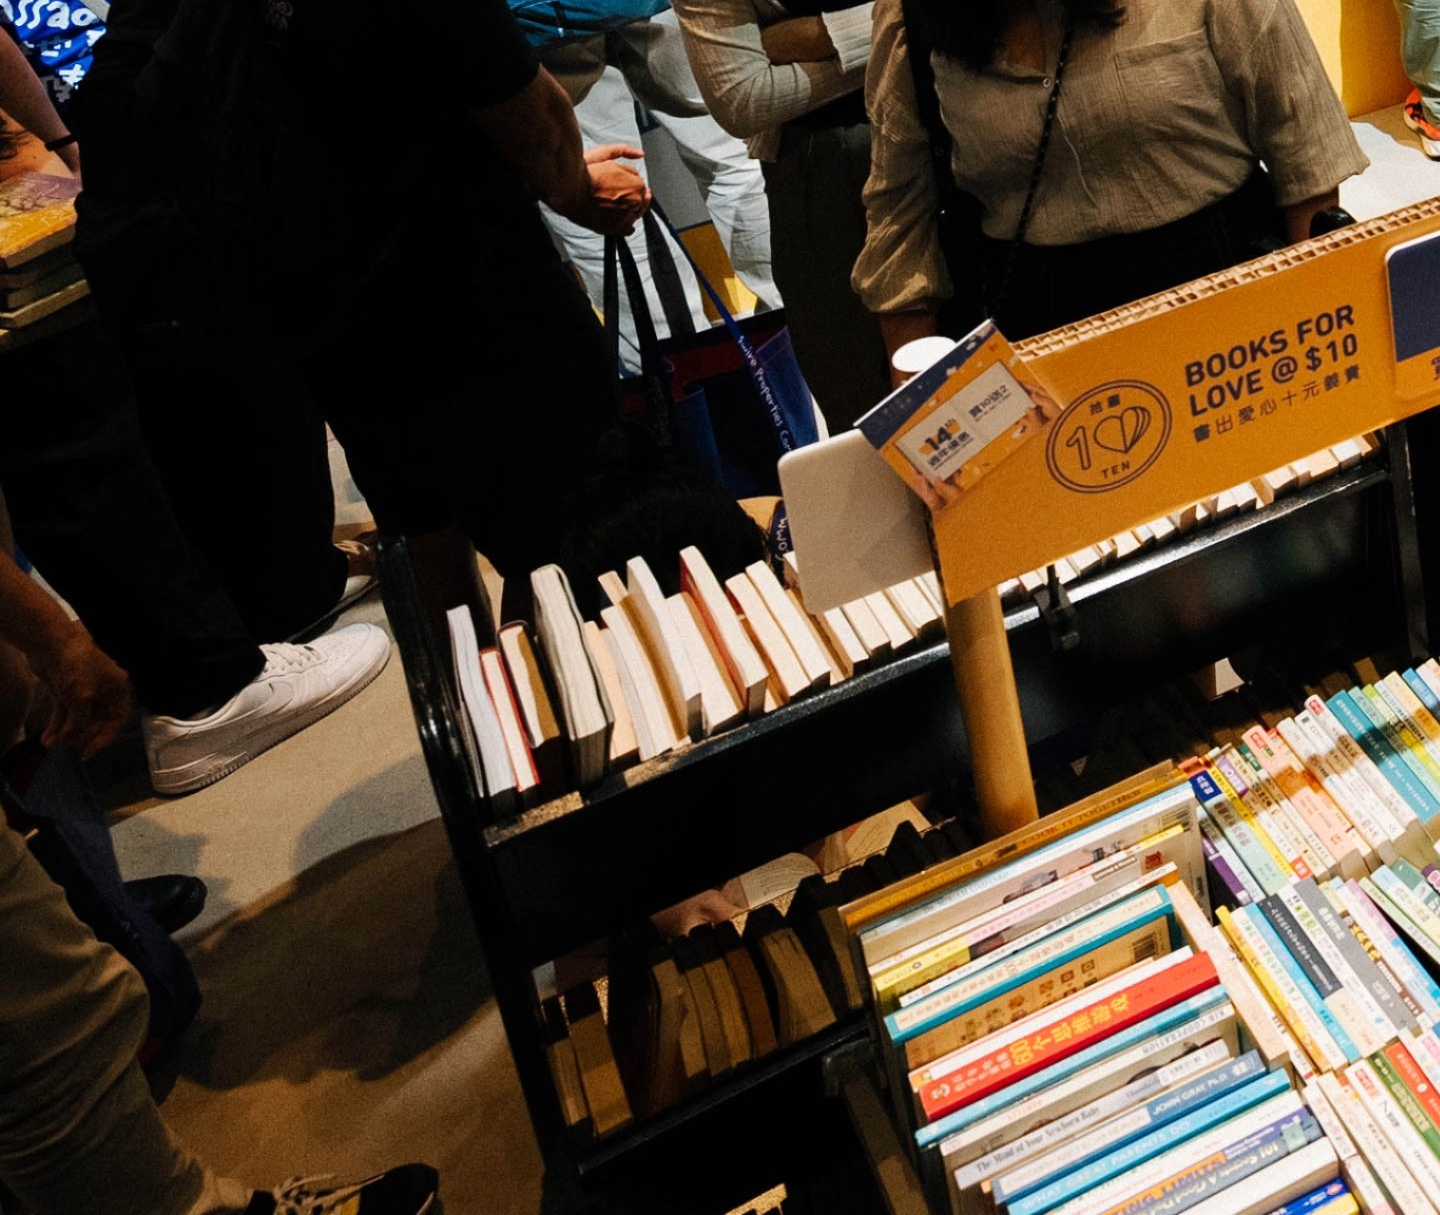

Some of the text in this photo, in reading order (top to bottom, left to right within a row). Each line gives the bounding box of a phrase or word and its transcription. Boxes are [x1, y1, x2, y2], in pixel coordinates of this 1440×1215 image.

[1185, 304, 1355, 388] BOOKS FOR
[1189, 333, 1358, 417] LOVE @ $10
[1101, 459, 1132, 479] TEN
[1153, 1093, 1182, 1117] JOHN
[977, 1159, 992, 1174] The
[994, 1149, 1014, 1167] Mind
[1027, 1135, 1043, 1152] Your
[1045, 1117, 1080, 1142] Newborn
[1021, 1184, 1061, 1211] WHAT
[1110, 1134, 1168, 1165] PARENTS
[1171, 1121, 1192, 1137] DO
